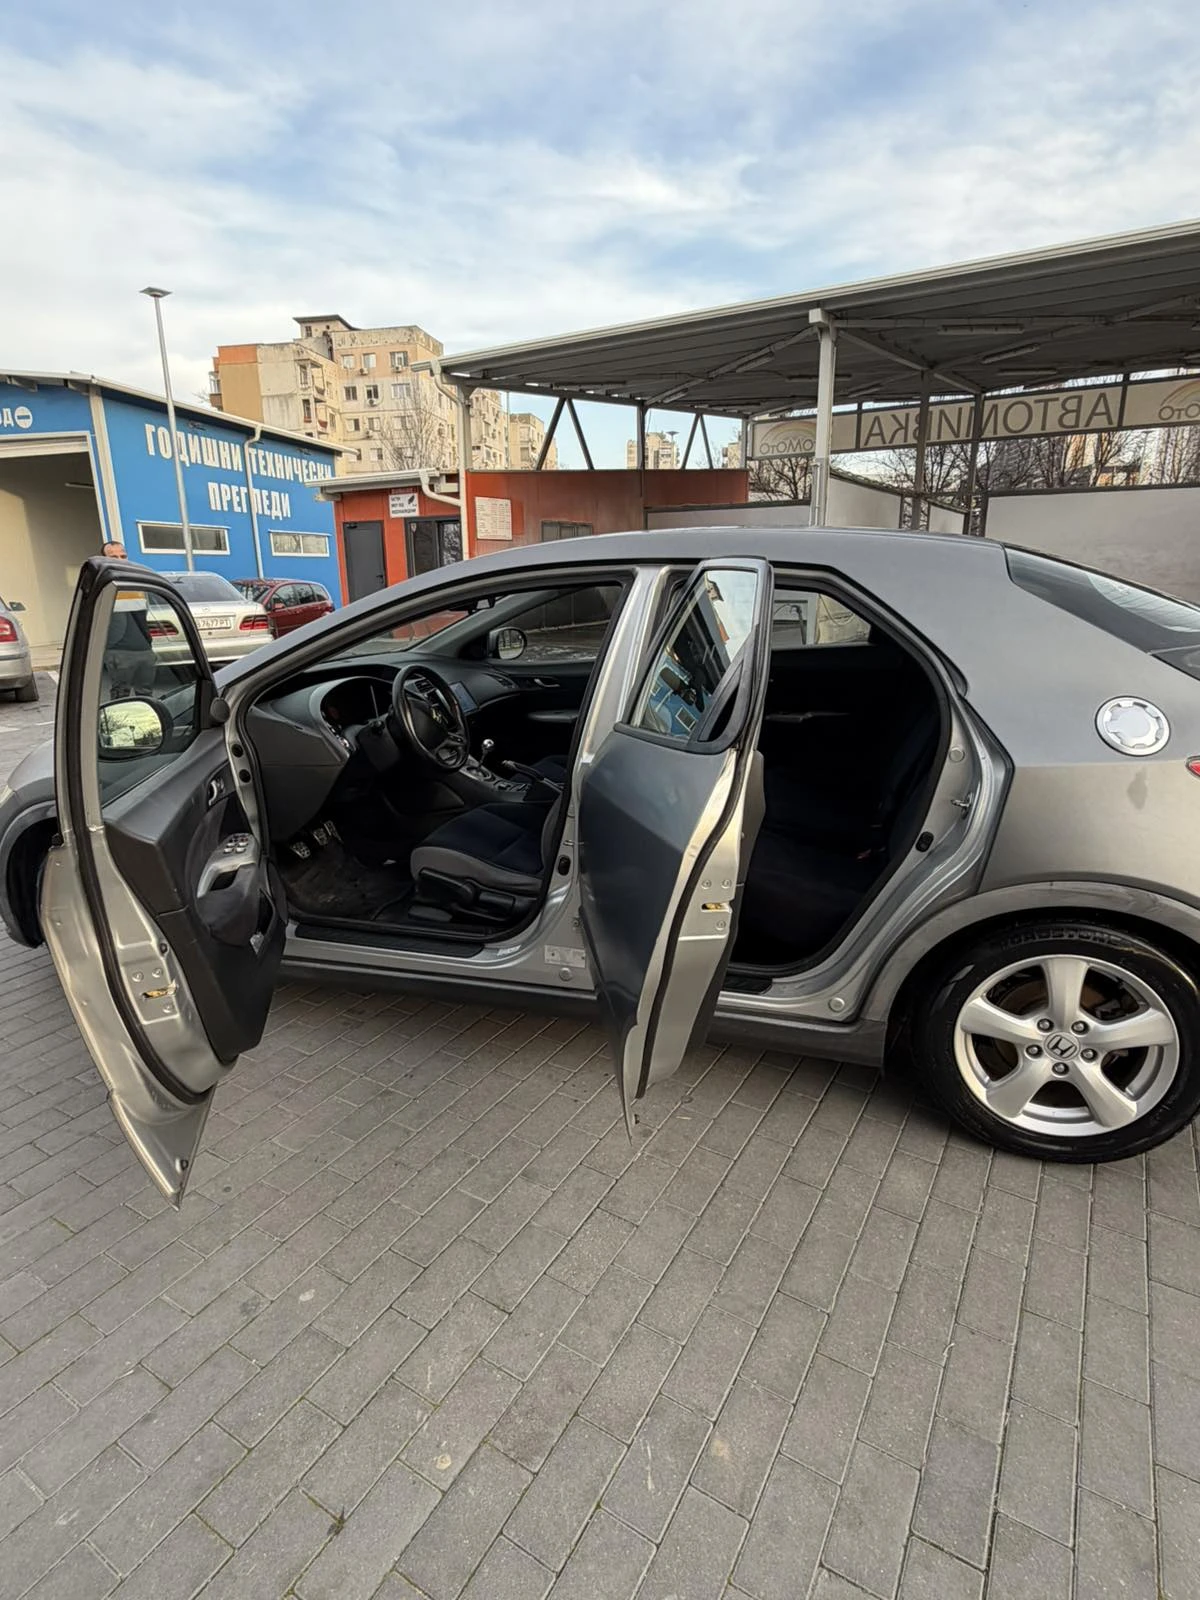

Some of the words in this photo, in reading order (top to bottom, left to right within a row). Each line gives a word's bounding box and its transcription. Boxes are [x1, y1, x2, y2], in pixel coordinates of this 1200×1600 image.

[145, 423, 243, 472] ГОДИШНИ
[248, 446, 332, 483] ТЕХНИЧЕСКИ
[207, 481, 291, 521] ПРЕГЛЕДИ
